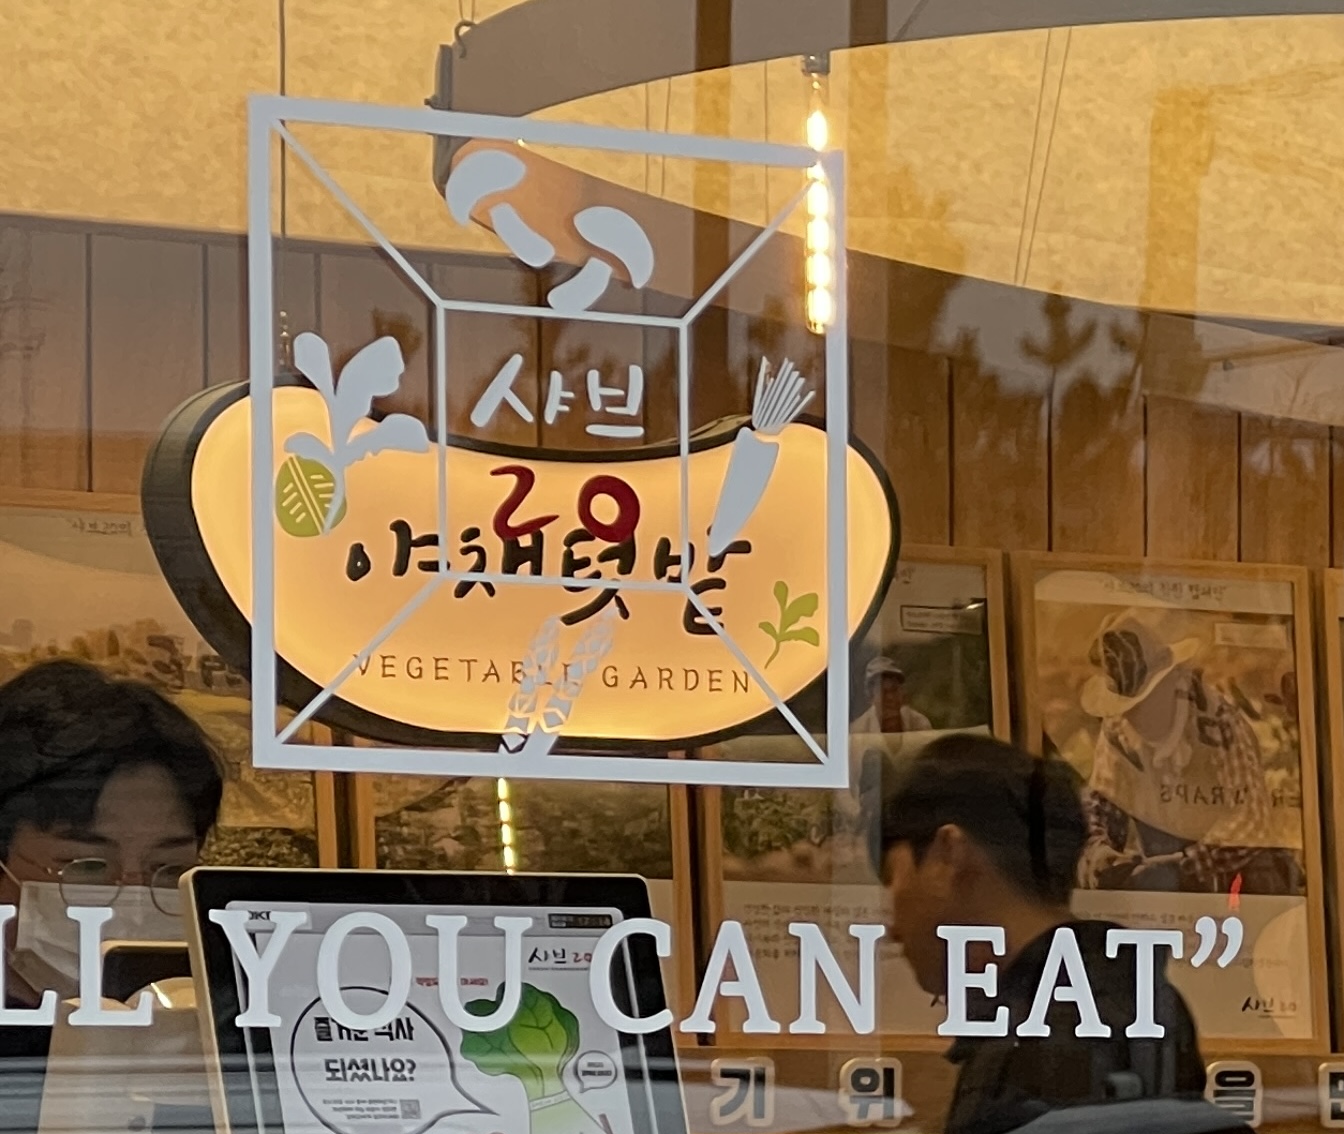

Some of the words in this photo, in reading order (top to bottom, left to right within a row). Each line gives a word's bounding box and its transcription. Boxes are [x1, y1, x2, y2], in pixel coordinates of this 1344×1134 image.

[470, 353, 644, 438] 샤브
[490, 465, 641, 543] 20
[353, 653, 582, 689] VEGETABLE
[601, 664, 754, 696] GARDEN
[208, 909, 533, 1034] YOU
[589, 918, 887, 1036] CAN
[324, 1057, 417, 1082] 되셨나요?
